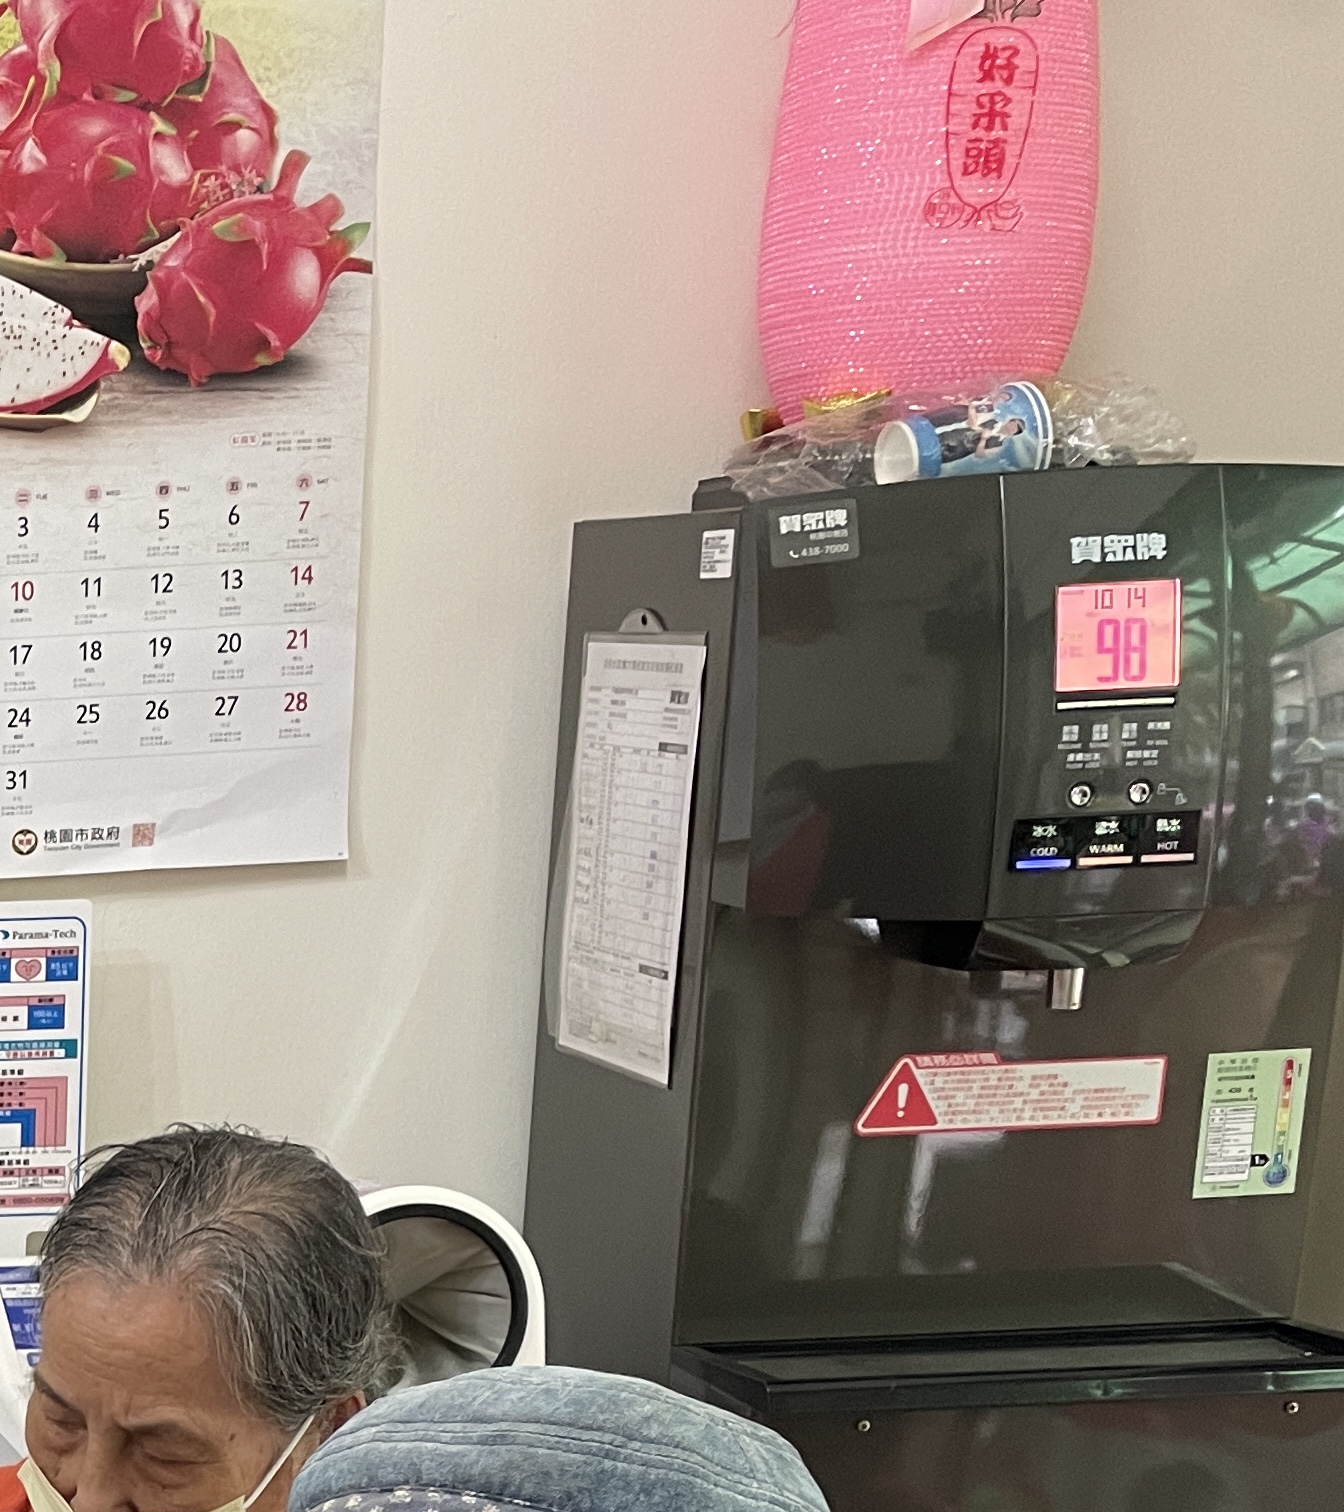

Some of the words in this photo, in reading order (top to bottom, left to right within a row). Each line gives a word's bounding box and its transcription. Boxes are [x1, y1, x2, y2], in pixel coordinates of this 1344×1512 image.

[17, 516, 29, 538] 3
[87, 512, 100, 534] 4
[158, 508, 170, 530] 5
[228, 504, 240, 526] 6
[299, 500, 310, 522] 7
[10, 580, 34, 602] 10
[80, 576, 102, 598] 11
[150, 572, 173, 594] 12
[220, 568, 243, 590] 13
[290, 564, 314, 586] 14
[1094, 588, 1114, 610] 10
[1127, 587, 1147, 608] 14
[9, 644, 33, 666] 17
[79, 640, 102, 662] 18
[148, 636, 172, 658] 19
[217, 632, 242, 654] 20
[286, 628, 308, 650] 21
[1096, 617, 1148, 683] 98
[7, 707, 32, 728] 24
[76, 703, 100, 724] 25
[145, 699, 169, 720] 26
[214, 695, 239, 717] 27
[284, 691, 308, 712] 28
[5, 769, 27, 790] 31
[44, 826, 121, 844] 桃園市政府
[1029, 846, 1058, 857] COLD
[1089, 843, 1125, 854] WARM
[1157, 840, 1179, 851] HOT
[11, 928, 78, 941] Parama-Tech
